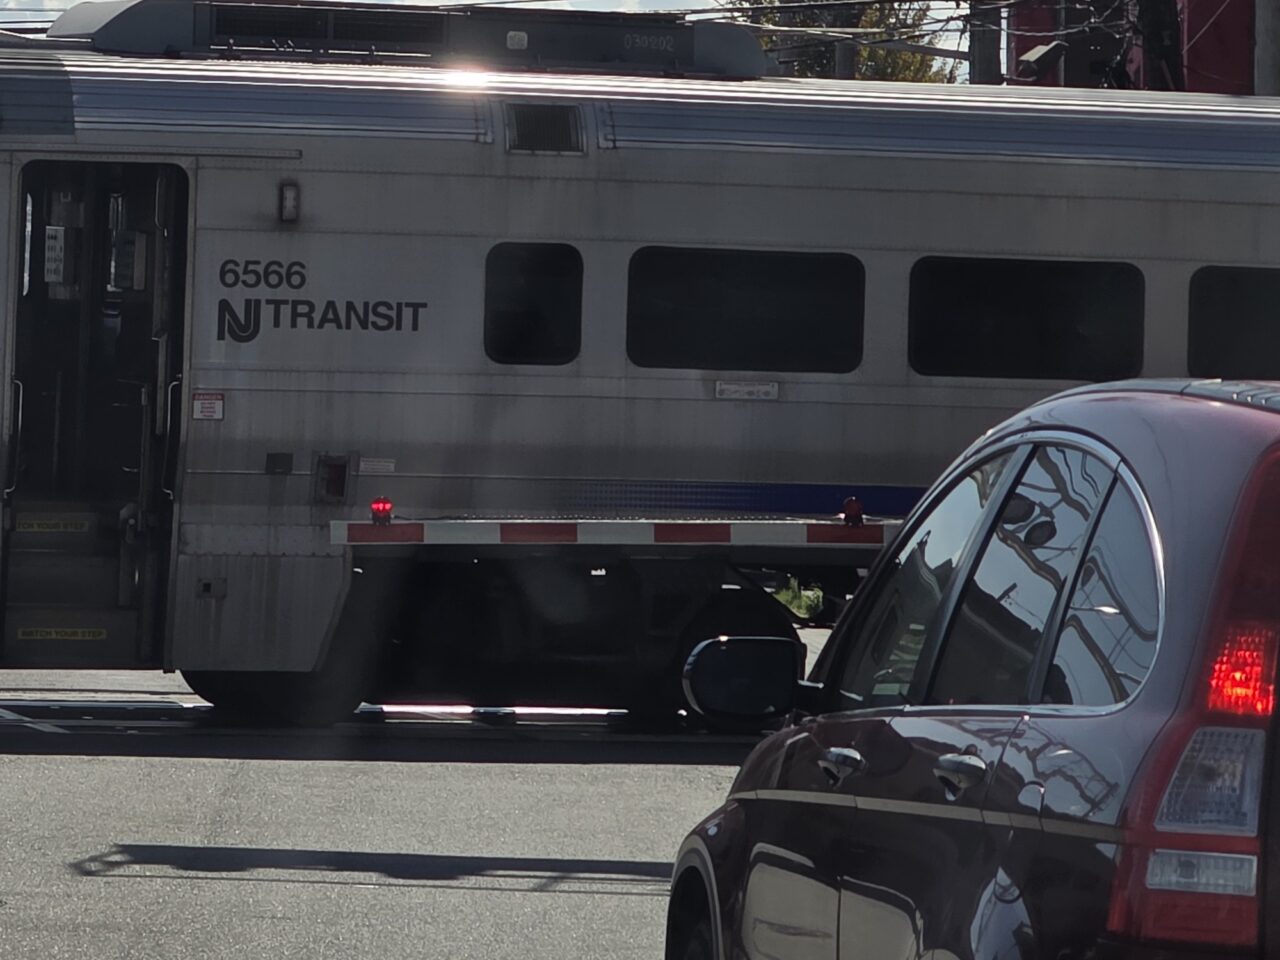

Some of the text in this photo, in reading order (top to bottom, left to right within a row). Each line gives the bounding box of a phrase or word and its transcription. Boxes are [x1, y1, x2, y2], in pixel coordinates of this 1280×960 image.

[624, 33, 674, 52] 030202
[219, 259, 307, 289] 6566
[265, 299, 428, 331] TRANSIT
[55, 629, 80, 638] YOUR
[81, 629, 104, 638] STEP
